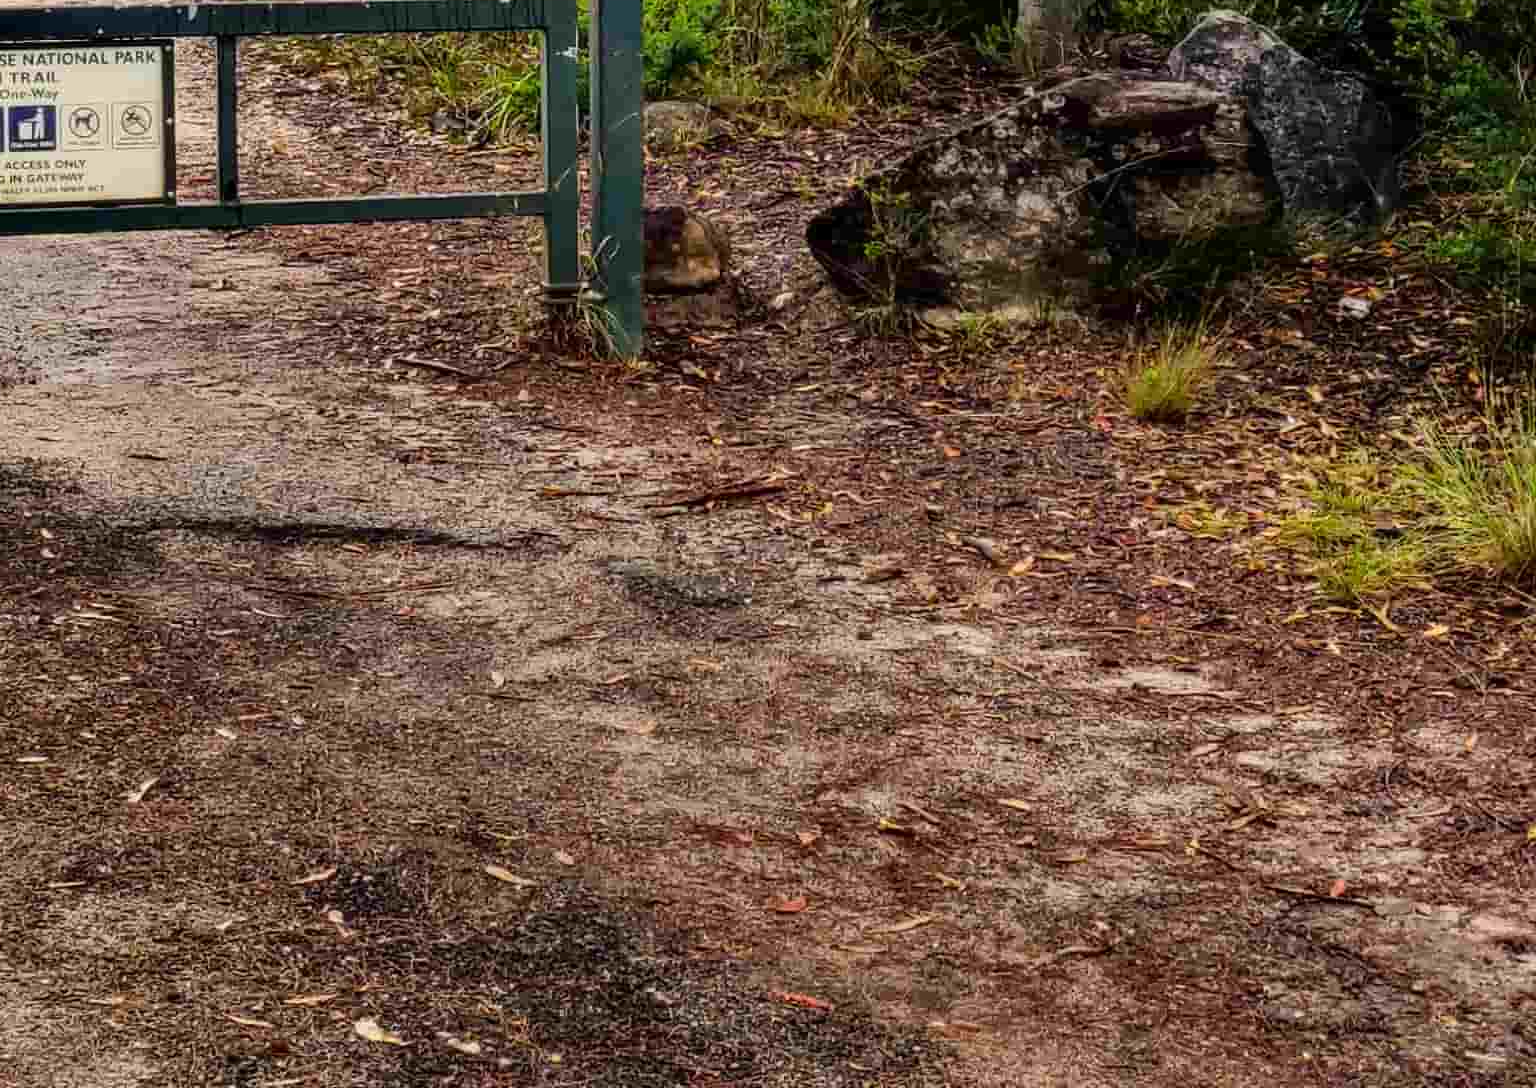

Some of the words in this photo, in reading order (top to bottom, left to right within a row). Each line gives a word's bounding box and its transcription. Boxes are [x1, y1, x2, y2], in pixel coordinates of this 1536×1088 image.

[22, 51, 109, 67] NATIONAL
[115, 50, 156, 64] PARK
[9, 70, 58, 84] TRAIL
[5, 159, 51, 171] ACCESS
[56, 158, 87, 170] ONLY
[9, 174, 23, 185] IN
[27, 173, 84, 184] GATEWAY
